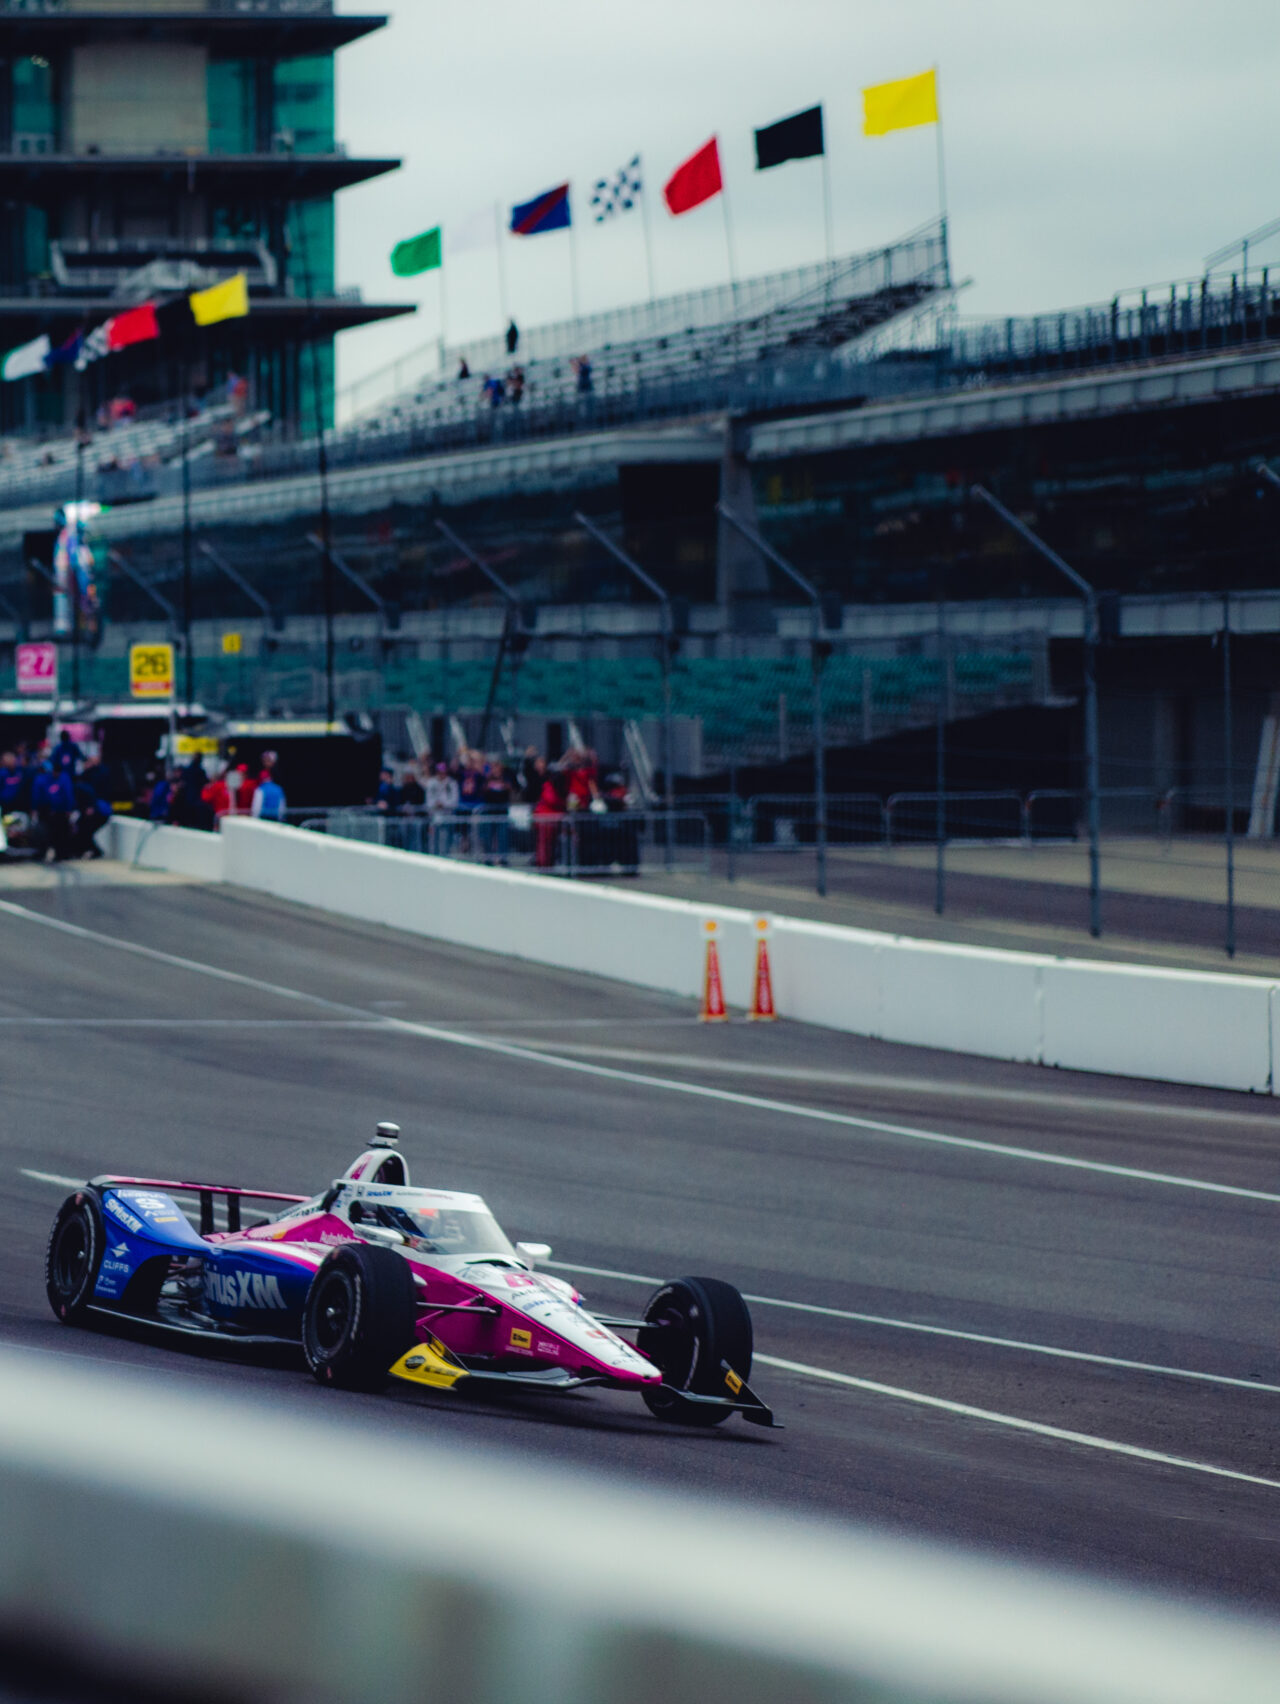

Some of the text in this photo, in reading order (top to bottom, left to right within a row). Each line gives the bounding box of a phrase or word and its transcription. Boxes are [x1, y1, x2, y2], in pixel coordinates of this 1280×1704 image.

[18, 648, 55, 677] 27
[135, 652, 168, 676] 26
[105, 1198, 143, 1233] SiriusXM
[103, 1259, 129, 1273] CLIFFS
